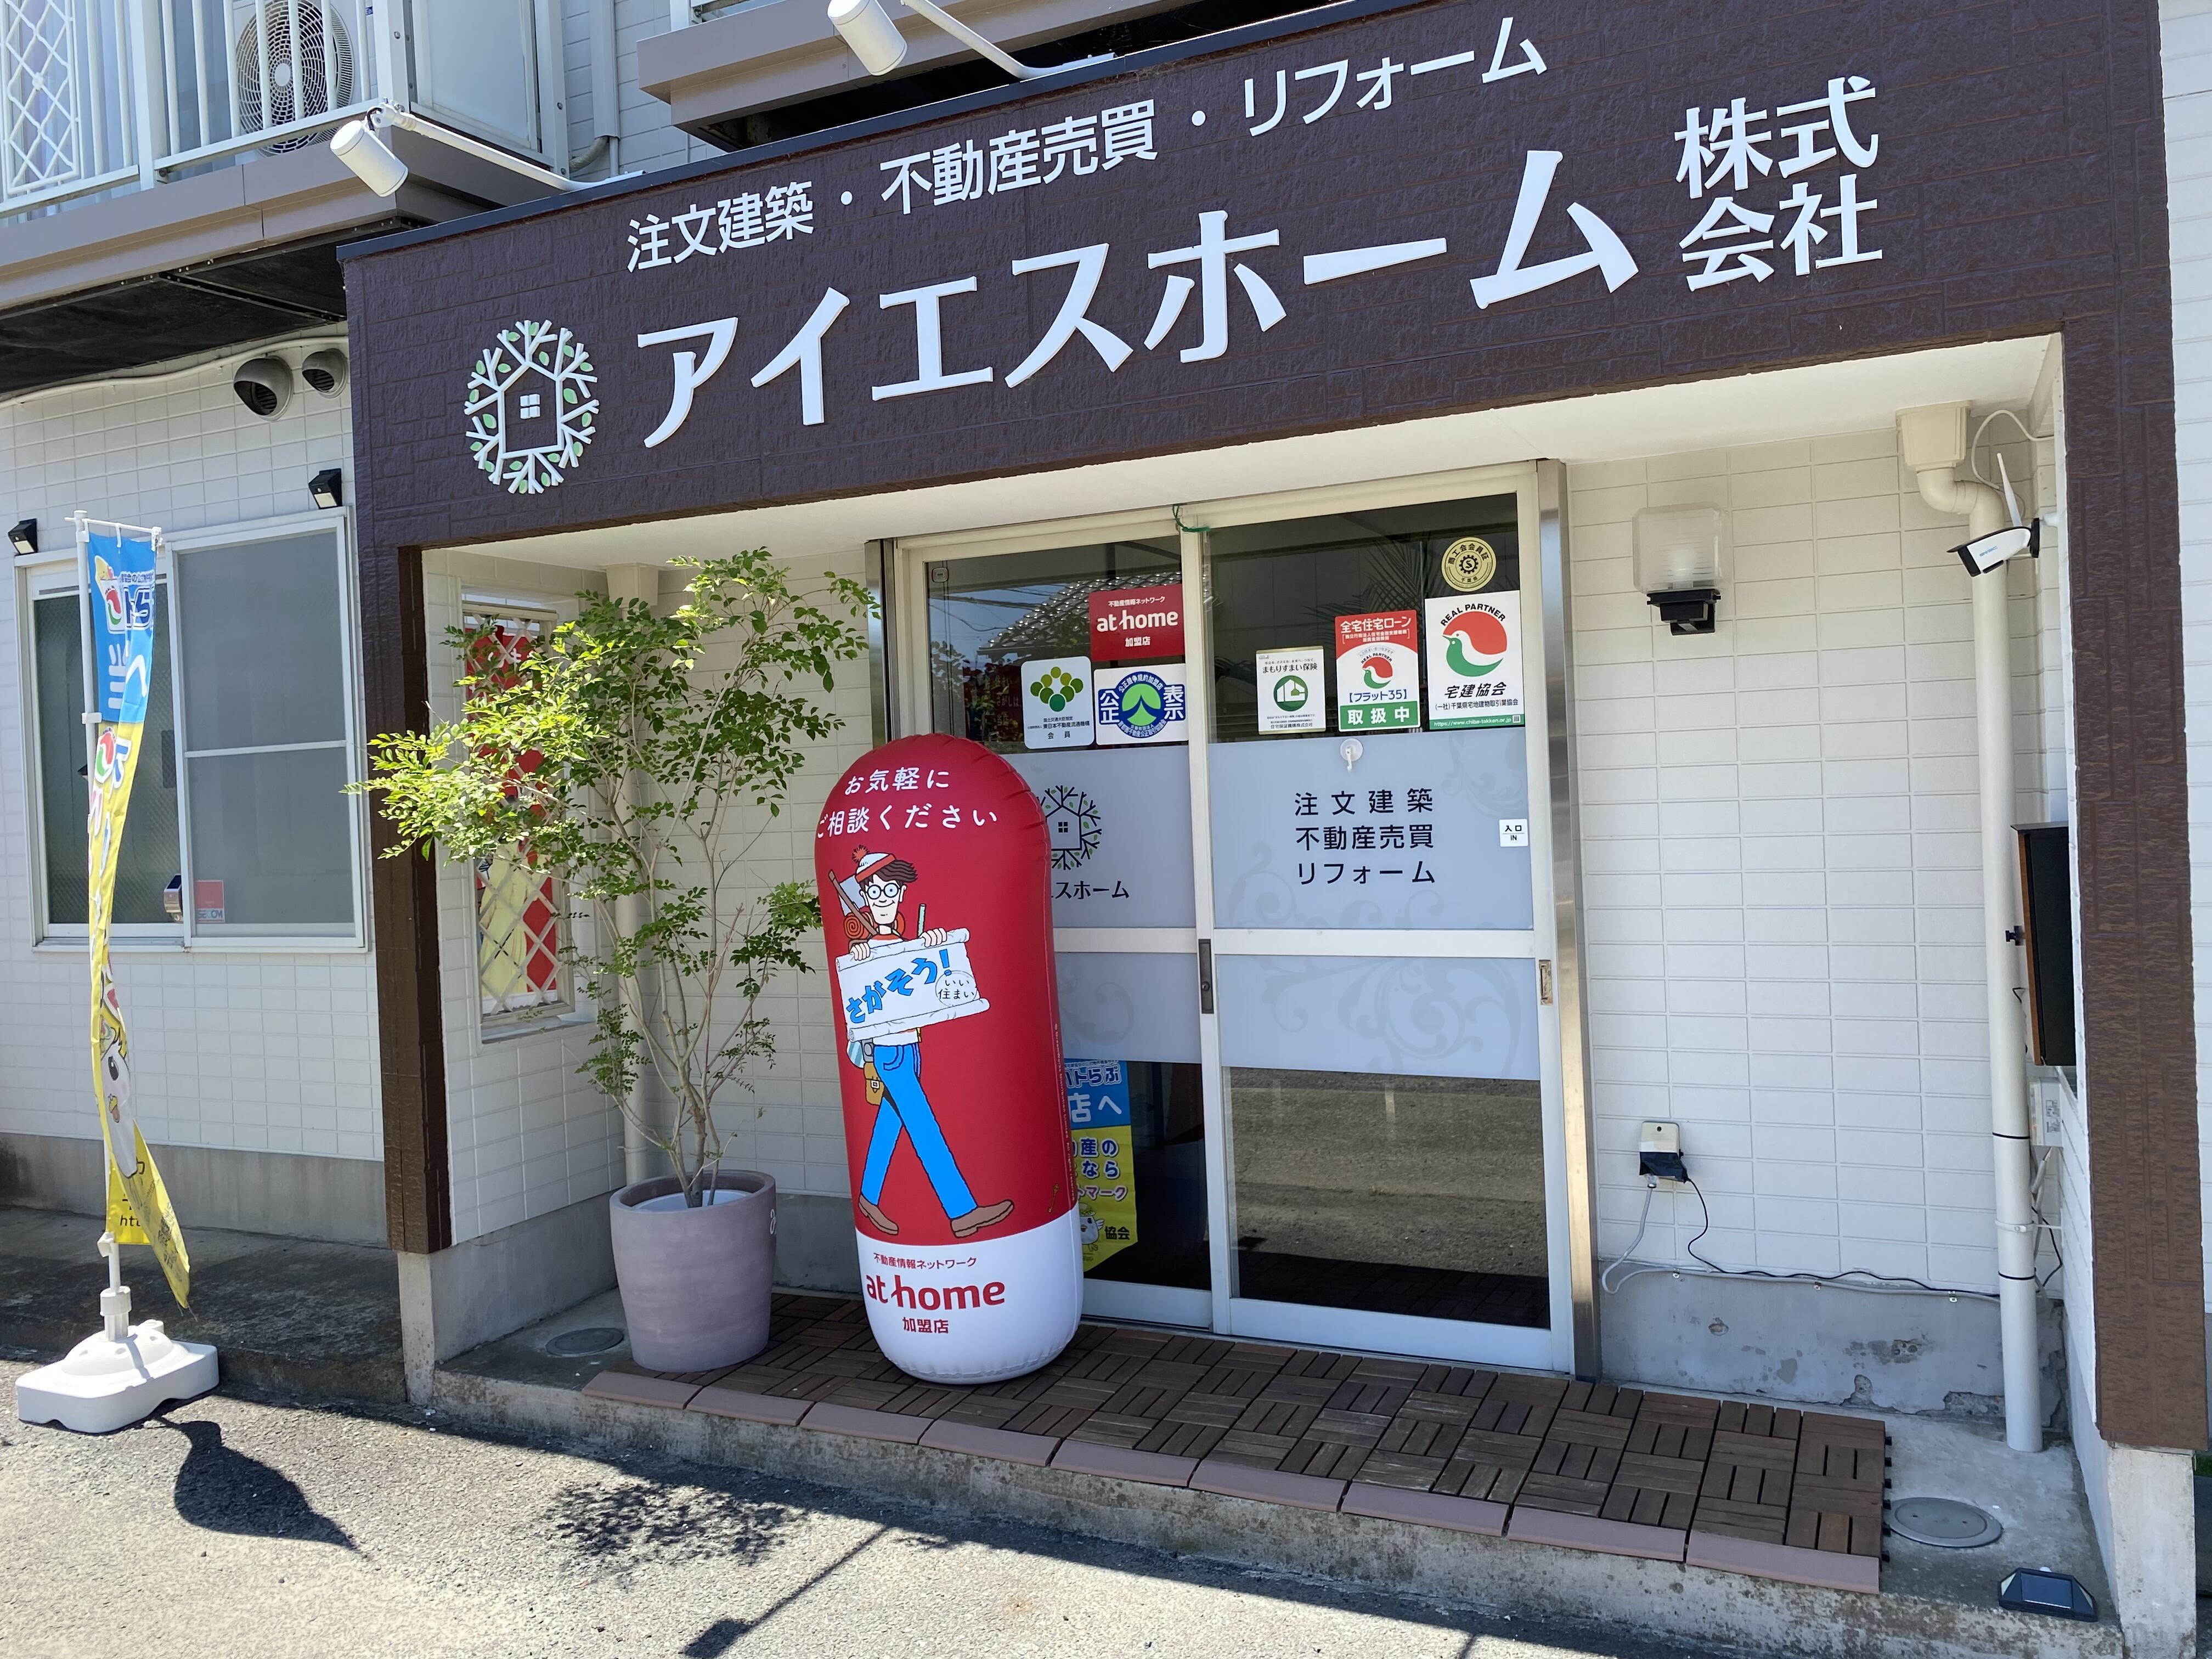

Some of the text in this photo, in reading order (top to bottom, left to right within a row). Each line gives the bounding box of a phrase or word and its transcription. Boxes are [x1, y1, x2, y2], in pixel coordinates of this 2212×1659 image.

[1673, 76, 1880, 200] 株式
[1679, 173, 1883, 292] 会社
[637, 150, 1639, 448] アイエスホーム
[1108, 596, 1165, 607] 不動産情報ネットワーク
[1441, 603, 1506, 627] REAL PARTNER
[1340, 617, 1412, 634] 全宅住宅ローン
[1125, 636, 1151, 647] 加盟店
[1361, 653, 1392, 664] REAL PARTNER
[1262, 663, 1318, 674] まもりすまい保険
[1349, 689, 1407, 703] 【フラット35】
[1444, 681, 1506, 699] 宅建協会
[1100, 690, 1120, 724] 公正
[1163, 685, 1184, 720] 表示
[1347, 706, 1410, 725] 取扱中
[844, 766, 950, 795] お気軽に
[1294, 788, 1433, 816] 注文建築
[816, 802, 998, 839] ご相談ください
[1295, 824, 1435, 851] 不動産売買
[1298, 861, 1436, 885] リフォーム
[1051, 880, 1130, 900] スホーム
[945, 979, 970, 987] いい
[938, 988, 974, 1000] 住まい
[1073, 1138, 1118, 1157] 産の
[1105, 1226, 1130, 1240] 協会
[873, 1252, 977, 1270] 不動産情報ネットワーク
[902, 1317, 949, 1334] 加盟店
